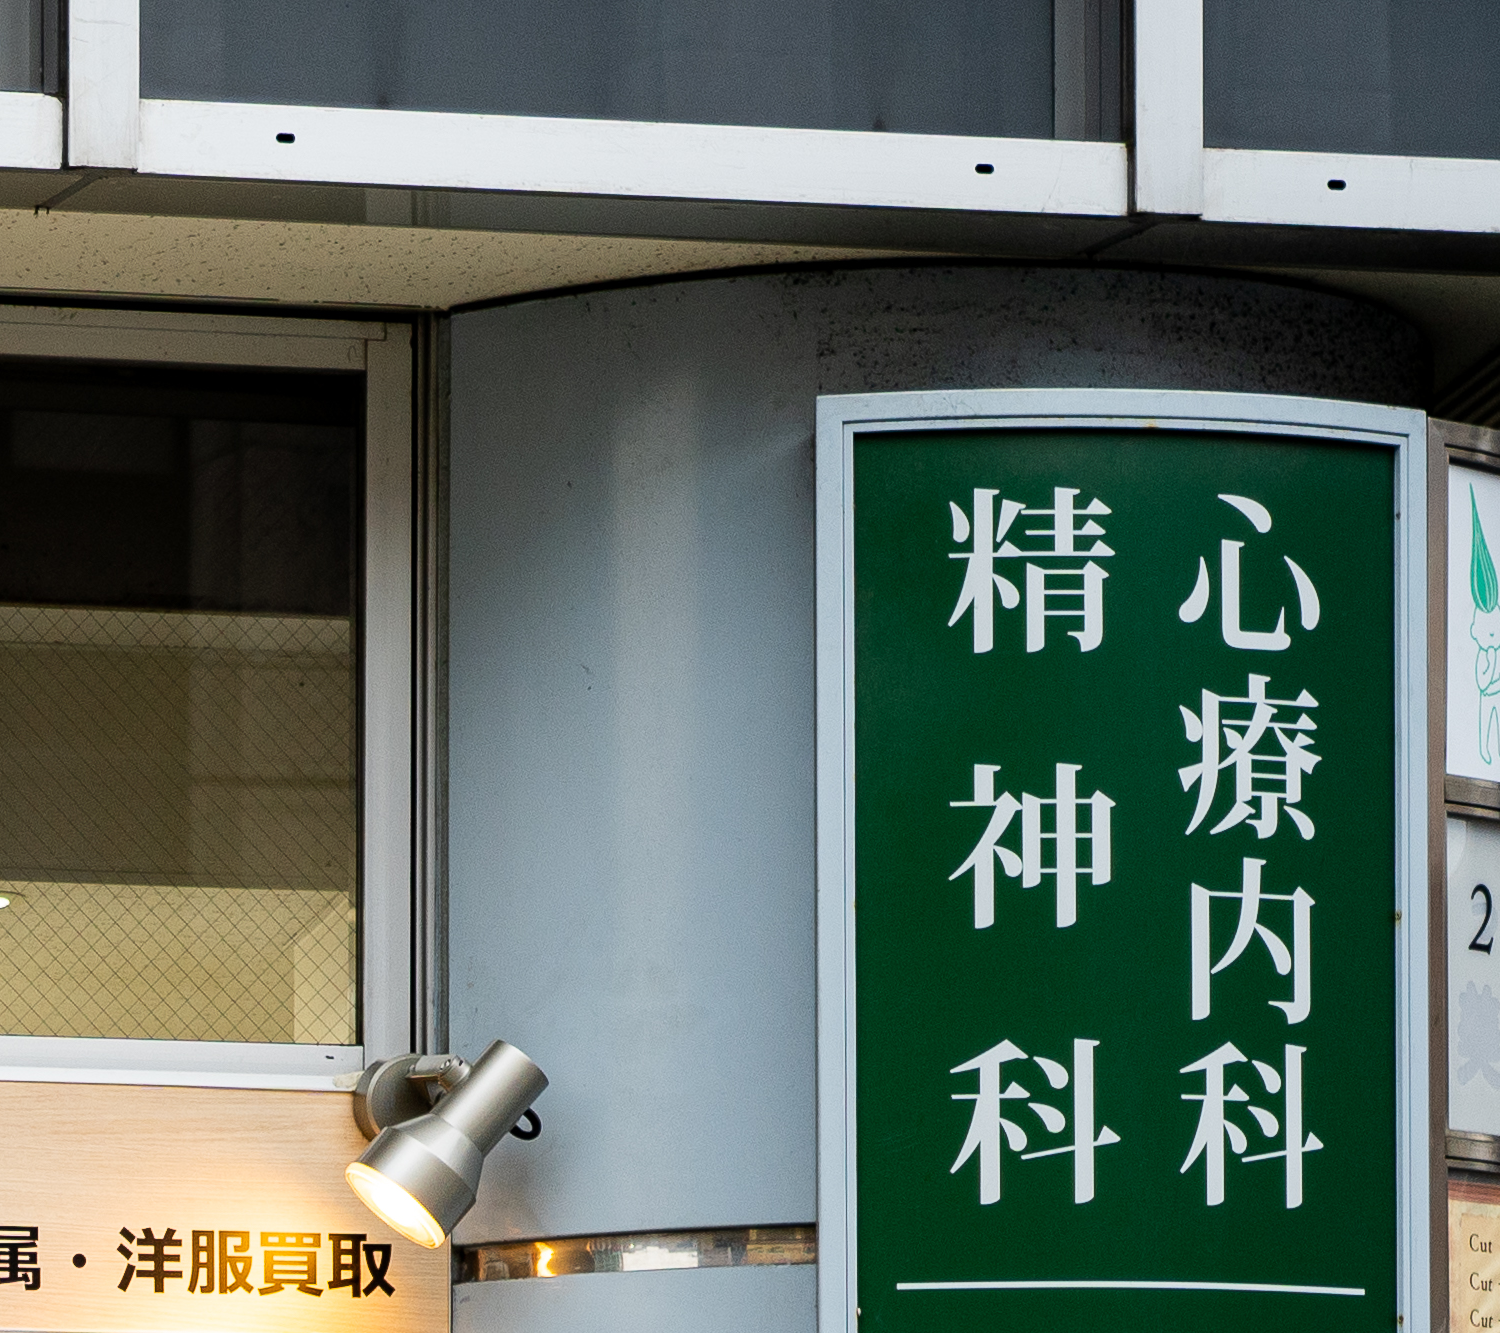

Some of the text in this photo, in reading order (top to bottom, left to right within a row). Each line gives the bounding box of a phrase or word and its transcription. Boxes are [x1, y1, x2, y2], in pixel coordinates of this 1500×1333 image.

[947, 485, 1121, 1205] 精神科
[1177, 492, 1324, 1210] 心療内科
[1469, 1233, 1493, 1254] Cut
[1469, 1271, 1493, 1293] Cut
[1469, 1308, 1493, 1329] Cut
